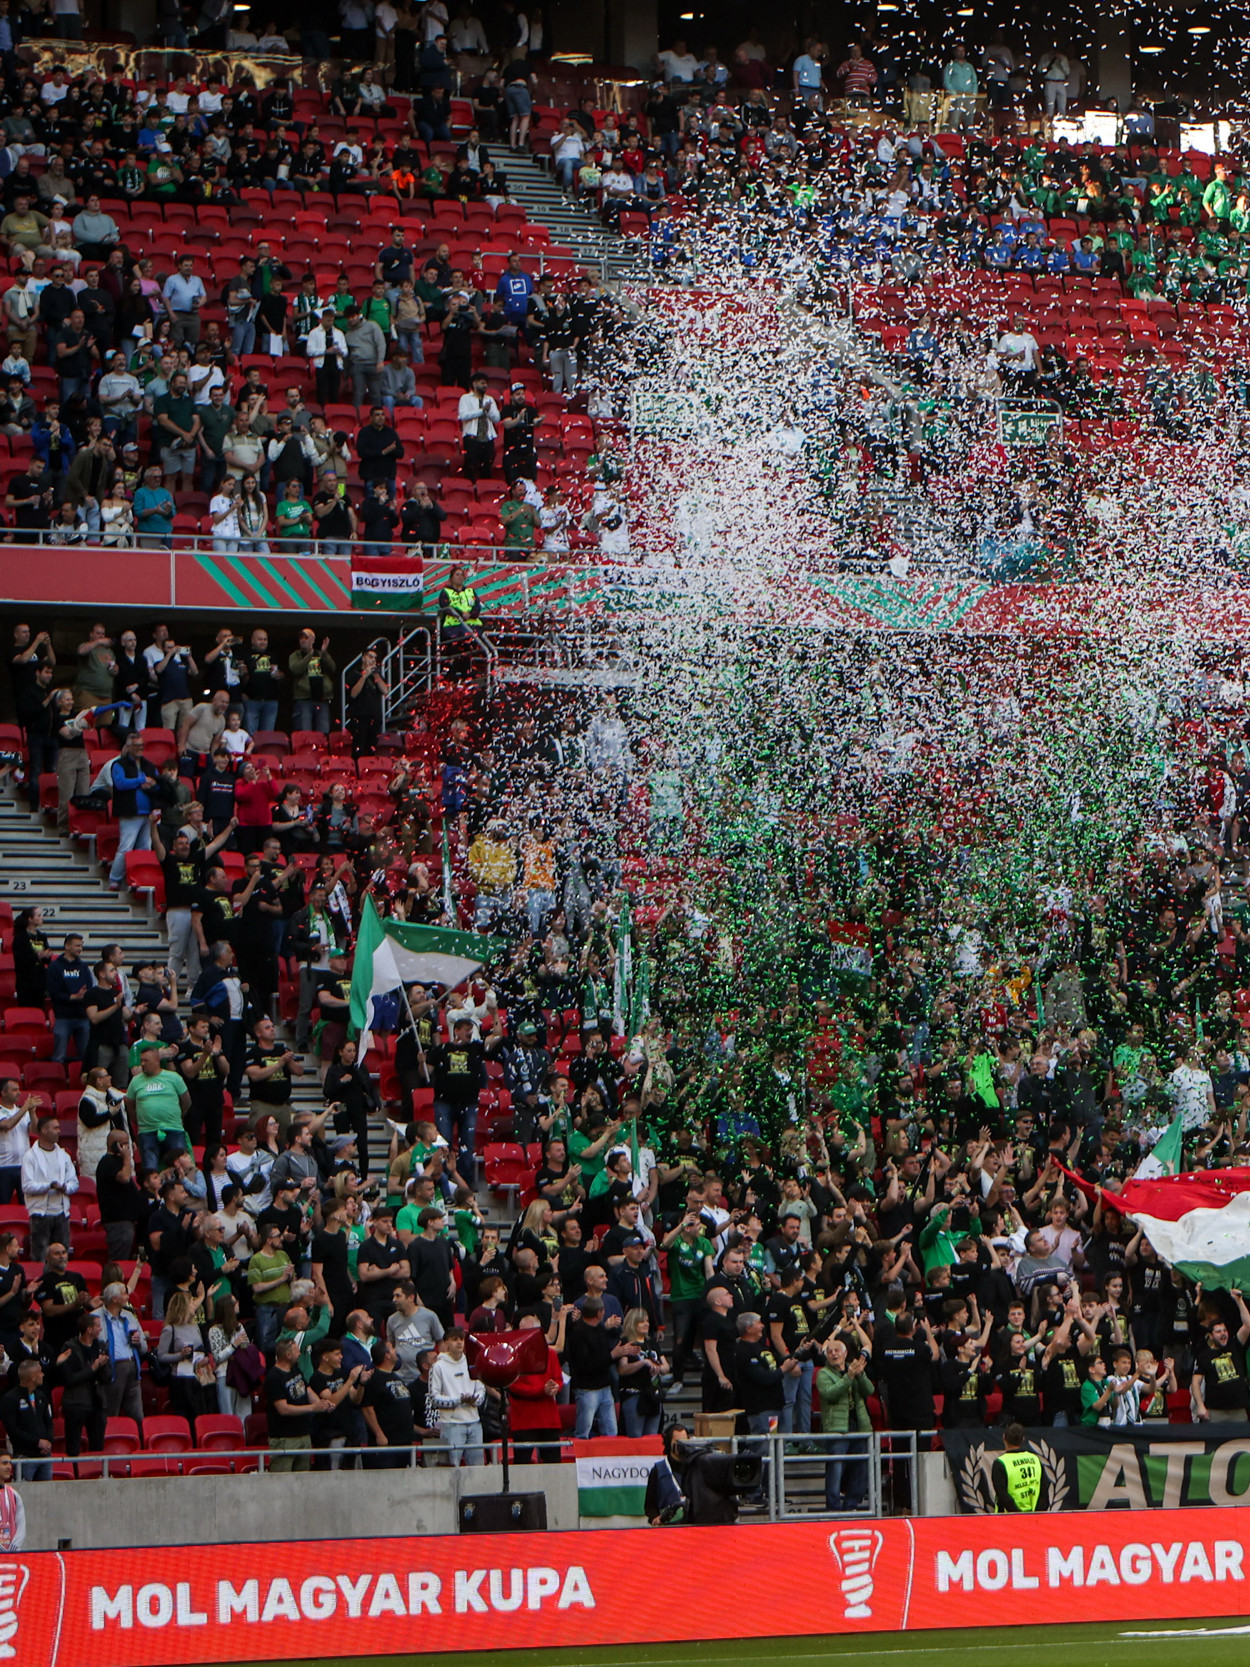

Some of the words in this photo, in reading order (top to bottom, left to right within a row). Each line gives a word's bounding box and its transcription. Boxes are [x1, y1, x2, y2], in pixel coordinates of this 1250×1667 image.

[13, 881, 26, 890] 23
[42, 908, 56, 917] 22
[592, 1466, 650, 1479] NAGYDO
[937, 1548, 1039, 1592] MOL
[1048, 1539, 1245, 1587] MAGYAR
[91, 1583, 207, 1629] MOL
[217, 1571, 442, 1622] MAGYAR
[455, 1565, 595, 1613] KUPA
